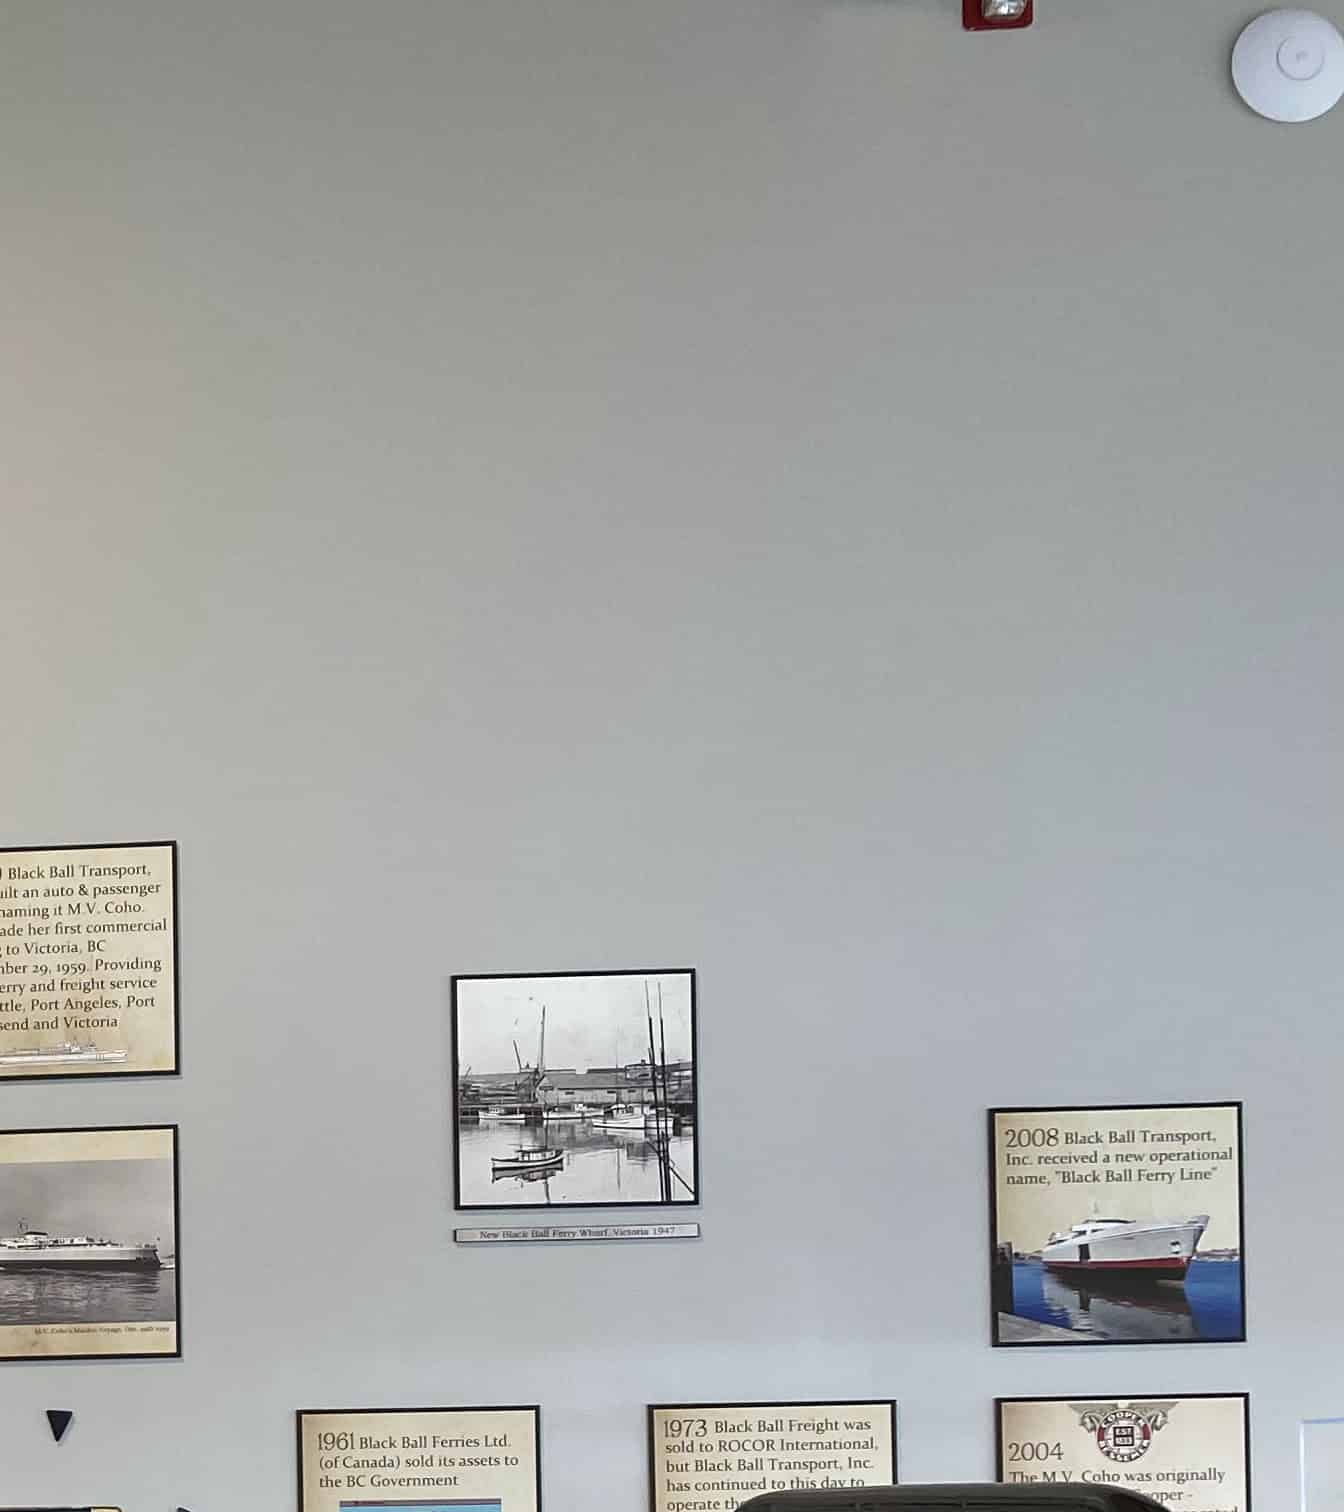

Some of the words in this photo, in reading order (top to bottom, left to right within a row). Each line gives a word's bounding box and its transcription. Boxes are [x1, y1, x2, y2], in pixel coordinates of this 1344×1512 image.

[7, 865, 45, 880] Black
[49, 864, 74, 878] Ball
[79, 861, 151, 880] Transport,
[22, 888, 39, 898] an
[43, 885, 73, 897] auto
[78, 883, 88, 895] &
[92, 884, 160, 898] passenger
[53, 903, 62, 915] it
[28, 922, 49, 935] her
[54, 921, 81, 934] first
[85, 918, 166, 933] commercial
[1004, 1127, 1059, 1148] 2008
[1064, 1131, 1103, 1145] Black
[1108, 1130, 1135, 1143] Ball
[1005, 1152, 1032, 1165] Inc.
[1037, 1150, 1097, 1164] received
[1102, 1153, 1110, 1162] a
[1115, 1153, 1143, 1162] new
[1148, 1147, 1233, 1165] operational
[1005, 1174, 1050, 1186] name,
[1105, 1169, 1131, 1182] Ball
[1137, 1168, 1175, 1185] Ferry
[480, 1230, 498, 1239] New
[663, 1419, 707, 1438] 1973
[714, 1419, 753, 1433] Black
[757, 1419, 783, 1432] Ball
[787, 1417, 839, 1435] Freight
[842, 1420, 871, 1430] was
[317, 1431, 354, 1451] 1961
[359, 1436, 397, 1449] Black
[401, 1436, 427, 1448] Ball
[432, 1435, 480, 1448] Ferries
[483, 1434, 511, 1447] Ltd.
[664, 1440, 694, 1453] sold
[698, 1441, 713, 1453] to
[717, 1438, 776, 1452] ROCOR
[779, 1436, 878, 1453] International,
[1007, 1441, 1064, 1461] 2004
[318, 1456, 340, 1471] (of
[342, 1455, 400, 1471] Canada)
[404, 1455, 433, 1467] sold
[437, 1456, 455, 1467] its
[458, 1455, 500, 1467] assets
[503, 1454, 519, 1466] to
[665, 1460, 690, 1472] but
[694, 1459, 732, 1472] Black
[737, 1458, 763, 1471] Ball
[767, 1456, 843, 1474] Transport,
[847, 1456, 874, 1469] Inc.
[319, 1475, 342, 1488] the
[346, 1474, 367, 1487] BC
[370, 1473, 459, 1487] Government
[1080, 1469, 1120, 1482] Coho
[1123, 1472, 1152, 1481] was
[1155, 1467, 1225, 1484] originally
